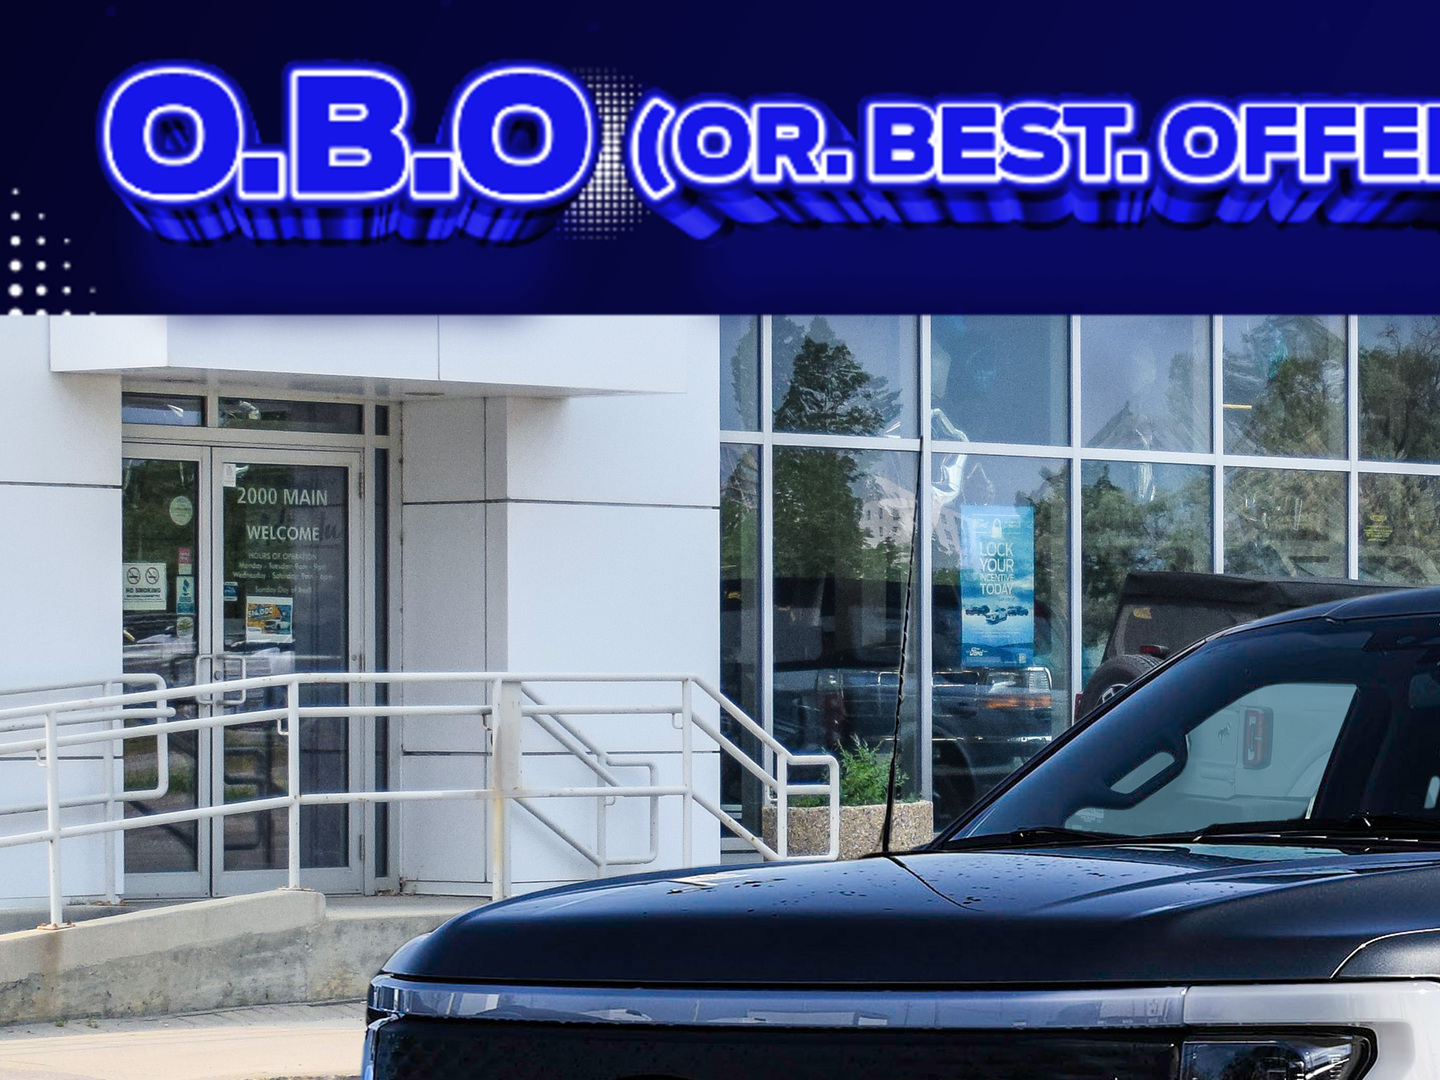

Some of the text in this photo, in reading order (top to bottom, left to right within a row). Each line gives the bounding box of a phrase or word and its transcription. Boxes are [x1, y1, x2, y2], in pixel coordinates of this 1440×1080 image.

[237, 487, 328, 507] 2000 MAIN
[246, 525, 320, 541] WELCOME
[249, 552, 271, 560] HOURS
[272, 552, 282, 560] OF
[979, 541, 1014, 557] LOCK
[979, 558, 1015, 572] YOUR
[980, 583, 1013, 595] TODAY
